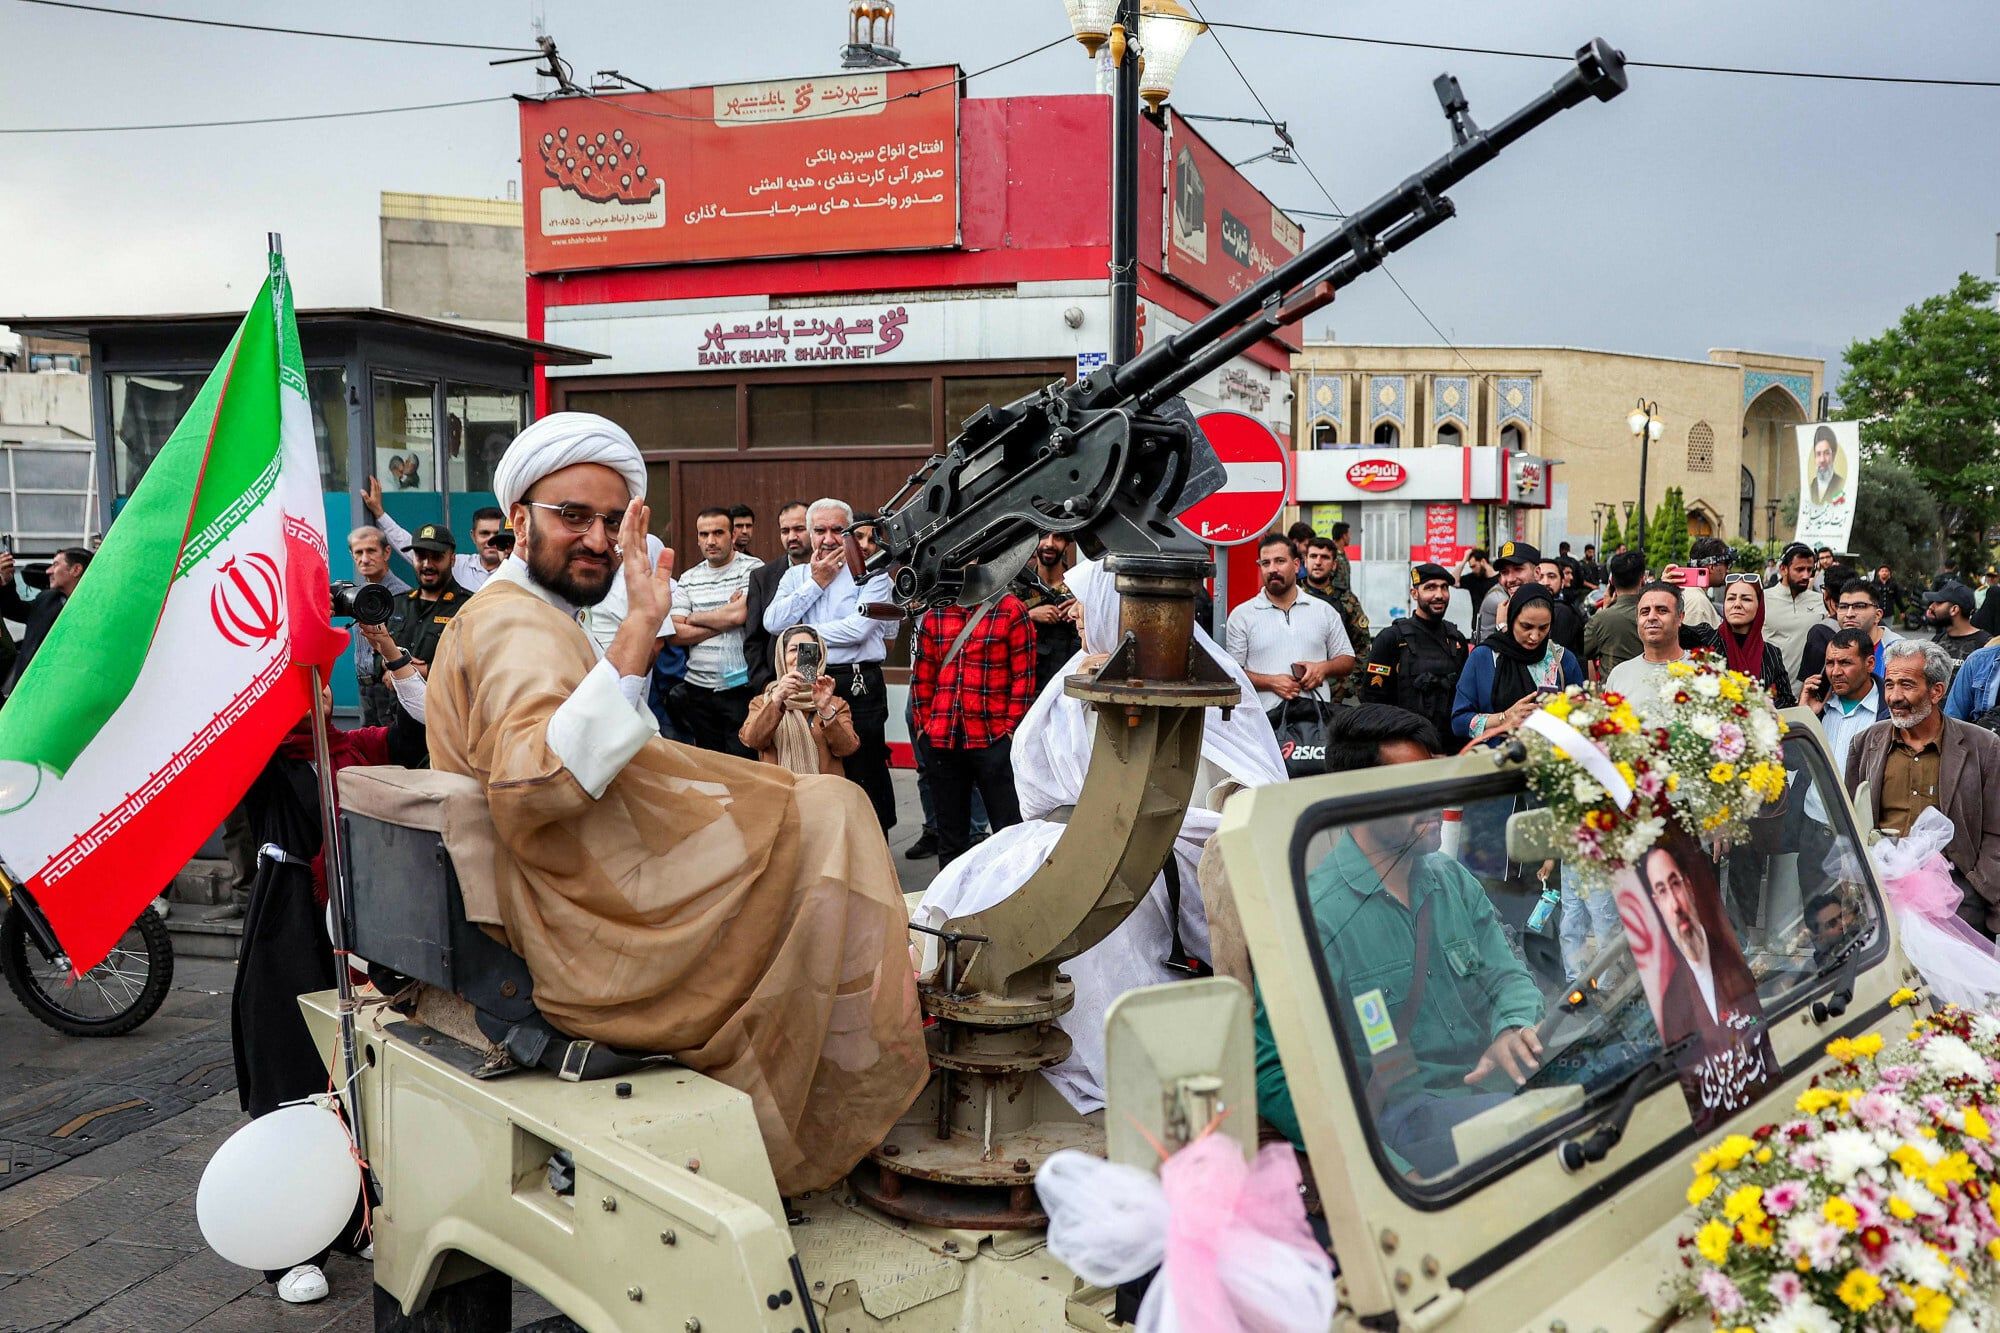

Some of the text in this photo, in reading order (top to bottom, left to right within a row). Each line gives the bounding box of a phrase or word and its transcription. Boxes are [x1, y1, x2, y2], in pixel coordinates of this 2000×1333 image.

[805, 139, 944, 167] افتتاح انواع سپرده بانکی
[786, 177, 815, 191] هدیه
[824, 172, 855, 190] نقدی
[857, 168, 885, 187] کارت
[888, 165, 909, 185] آنی
[911, 168, 944, 184] صدور
[748, 176, 783, 195] المثنی
[637, 211, 658, 222] نظارت
[684, 192, 944, 224] صدور واحد های سرمایه گذاری
[586, 217, 608, 227] مردمی
[611, 213, 630, 225] ارتباط
[698, 345, 874, 365] BANK SHAHR SHAHR NET
[1350, 464, 1399, 476] نان رضوی
